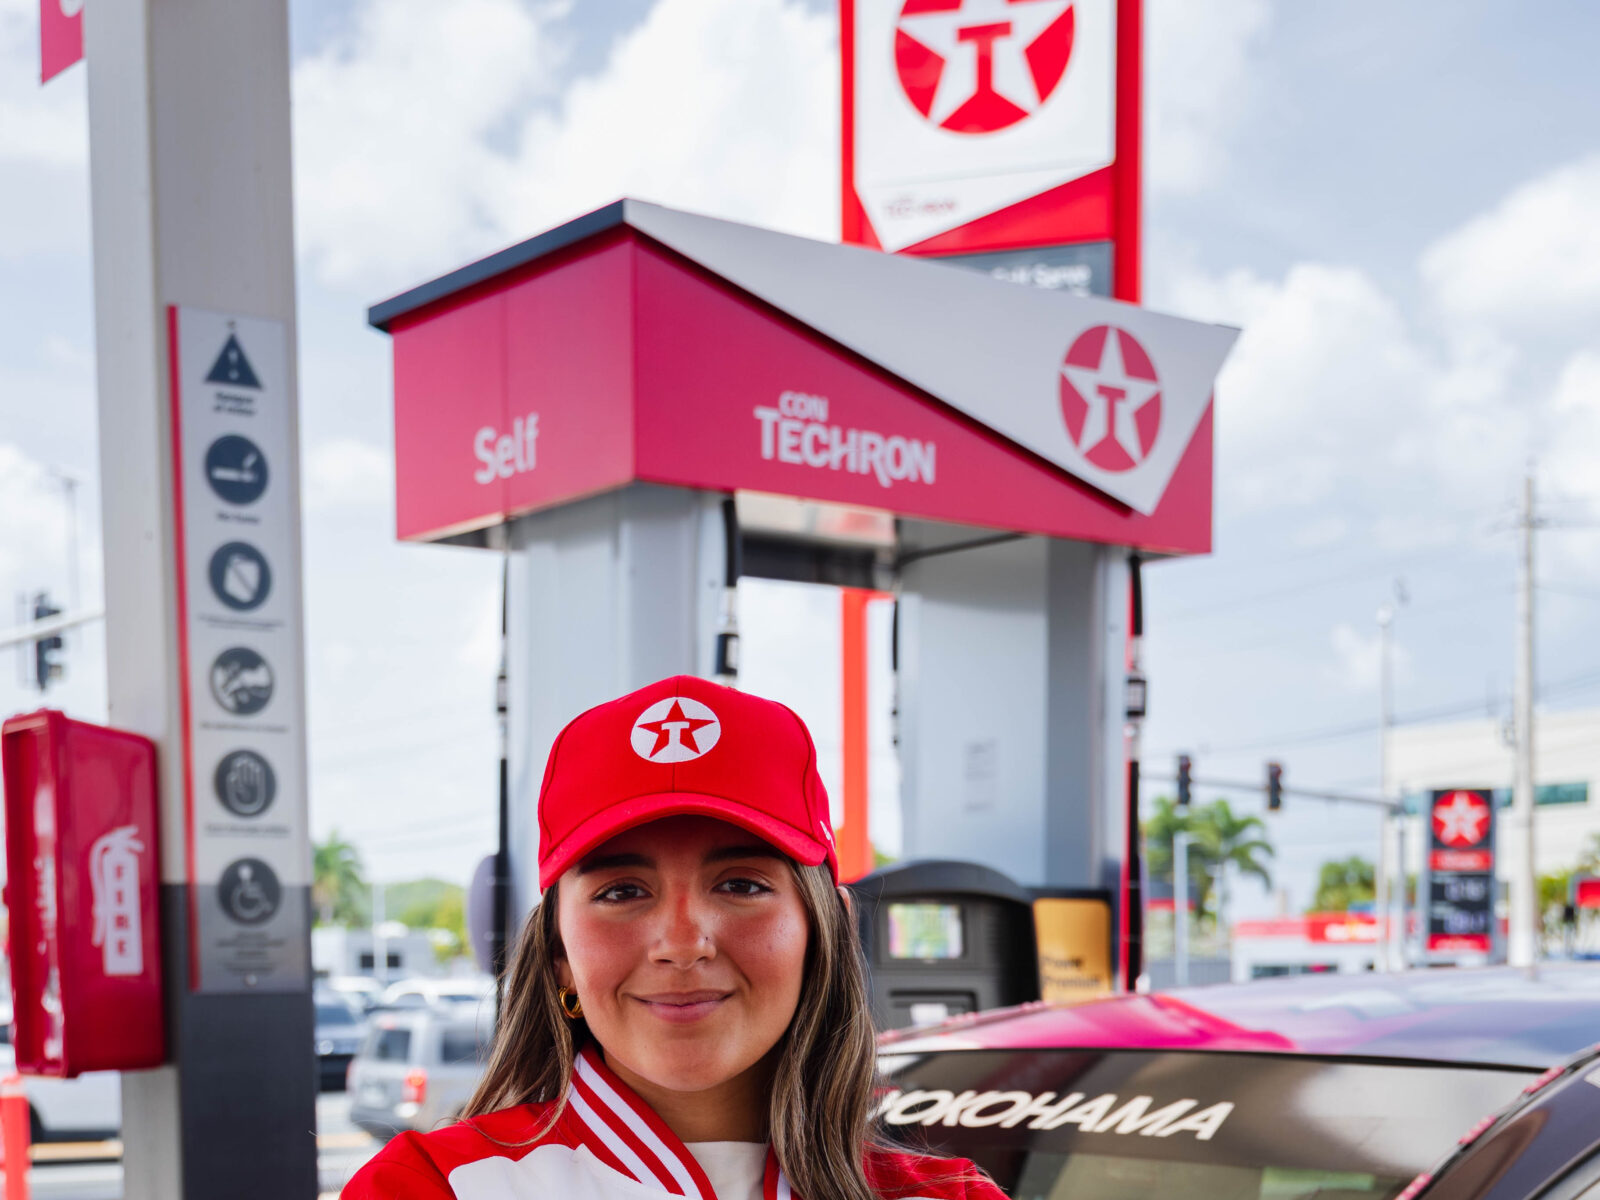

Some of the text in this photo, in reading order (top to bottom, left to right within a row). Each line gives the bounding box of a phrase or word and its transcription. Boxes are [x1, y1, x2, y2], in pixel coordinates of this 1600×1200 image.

[779, 391, 829, 422] CON
[474, 411, 539, 484] Self
[753, 405, 937, 488] TECHRON
[115, 864, 129, 957] FIRE
